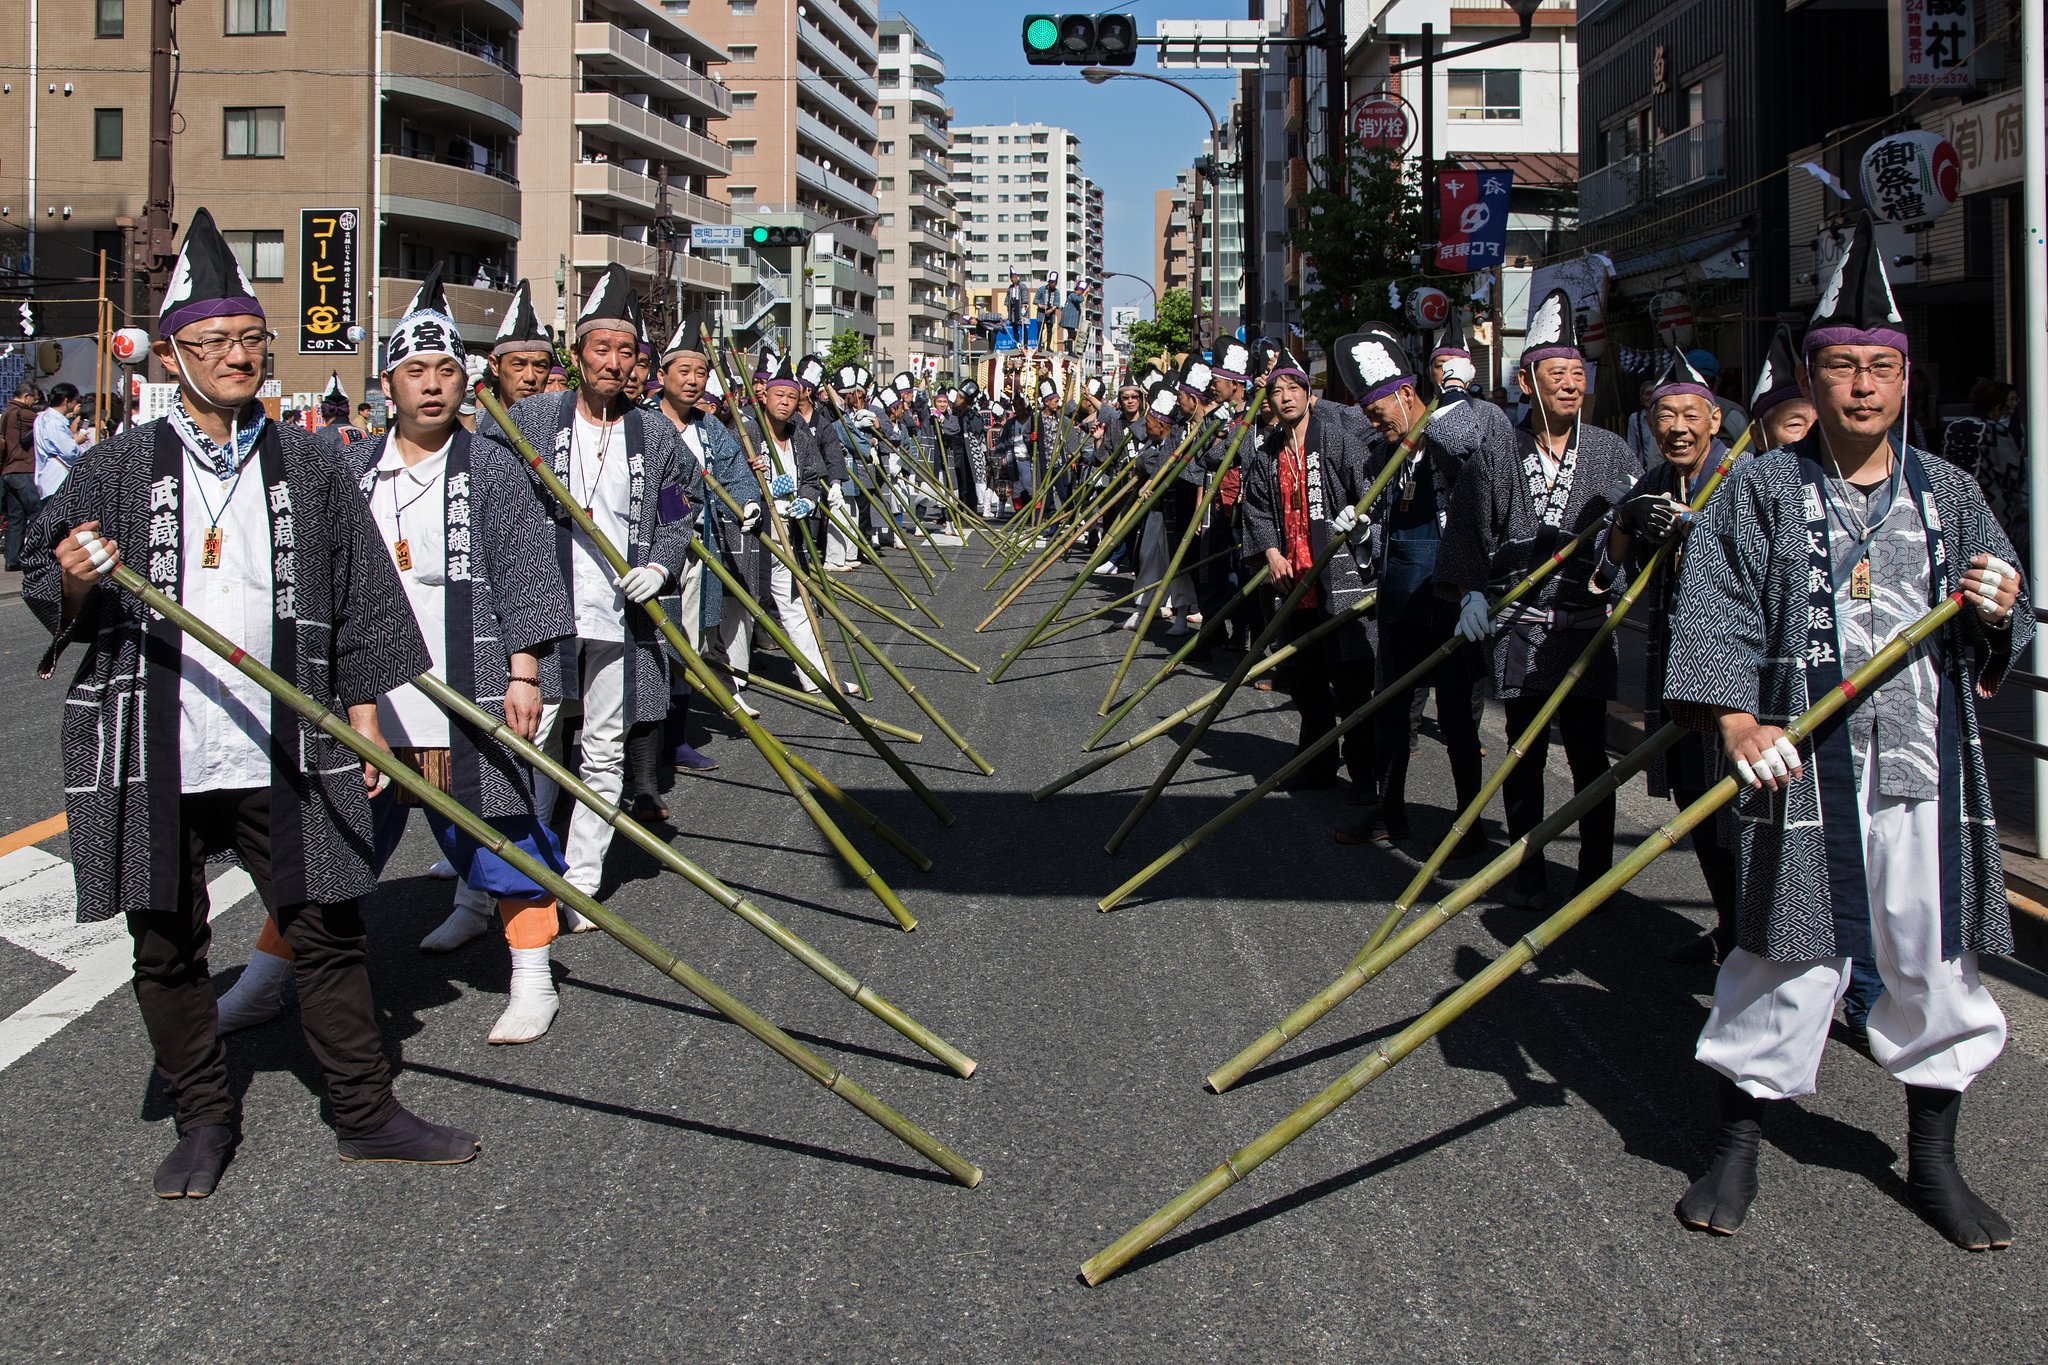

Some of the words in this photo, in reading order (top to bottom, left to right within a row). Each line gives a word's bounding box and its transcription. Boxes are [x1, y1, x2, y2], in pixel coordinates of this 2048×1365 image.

[1362, 107, 1374, 115] FIRE
[1375, 107, 1398, 115] HYDRANT
[1358, 116, 1404, 139] 消火栓
[693, 227, 741, 238] 宮町二丁目
[307, 339, 335, 350] この下
[1855, 574, 1869, 595] 本田
